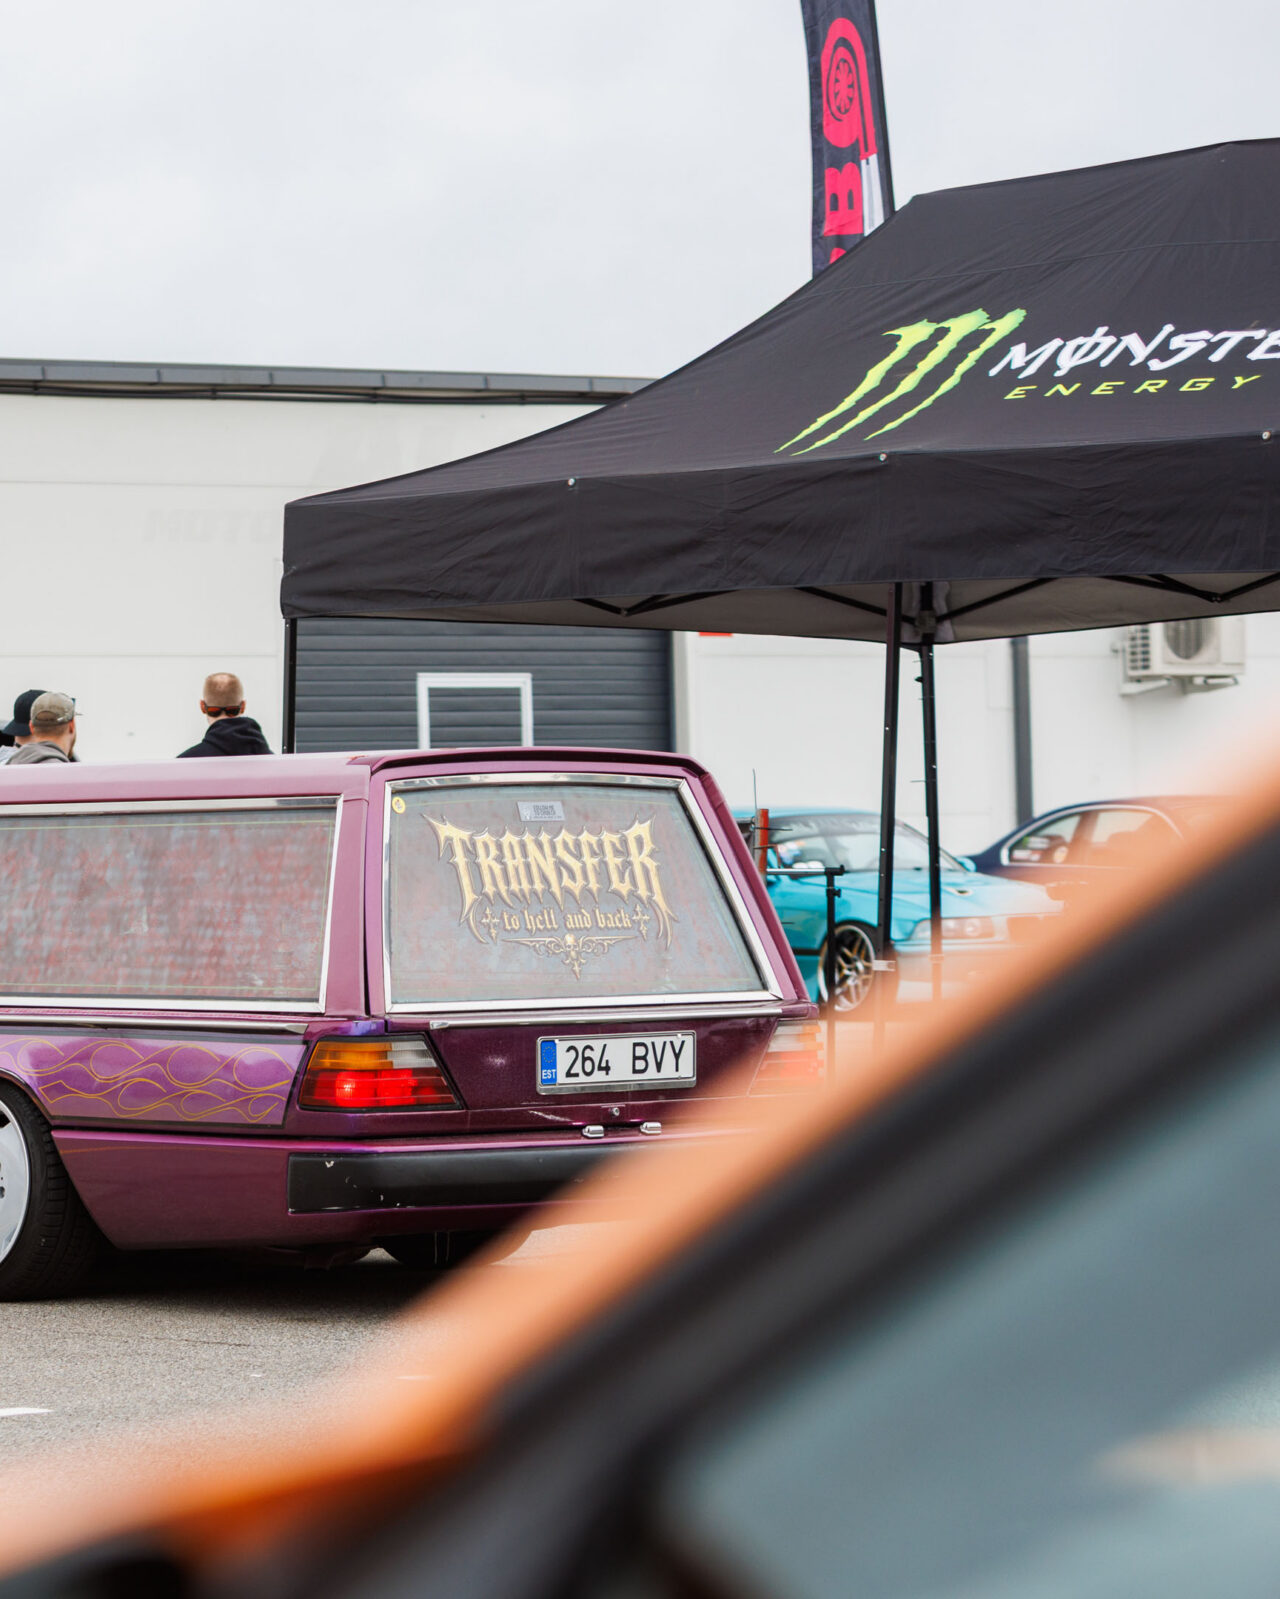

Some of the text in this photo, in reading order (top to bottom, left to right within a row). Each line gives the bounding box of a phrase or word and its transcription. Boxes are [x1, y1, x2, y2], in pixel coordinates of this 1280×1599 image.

[1003, 374, 1263, 400] ENERGY
[421, 813, 678, 928] TRANSFER
[503, 906, 633, 936] to hell and back
[542, 1039, 687, 1080] EST 264 BVY
